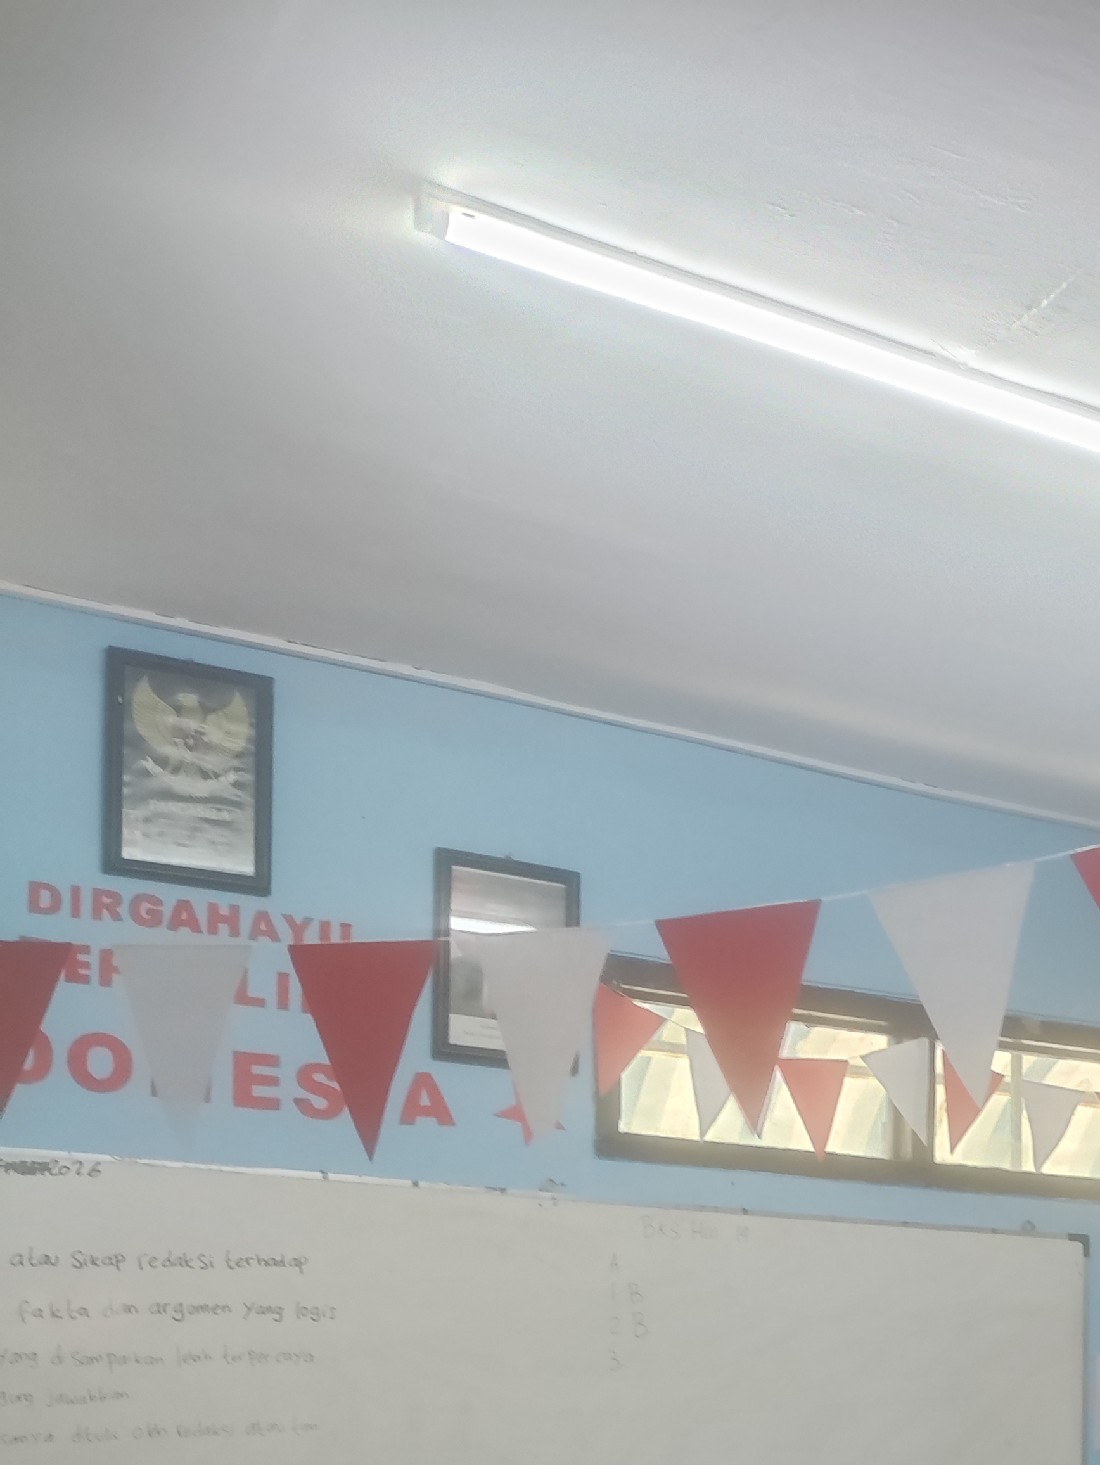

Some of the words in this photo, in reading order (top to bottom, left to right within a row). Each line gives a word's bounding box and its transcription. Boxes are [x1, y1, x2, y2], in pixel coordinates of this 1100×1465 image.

[28, 881, 353, 943] DIRGAHAYU
[224, 1250, 310, 1275] terhadap
[17, 1300, 90, 1323] fakta
